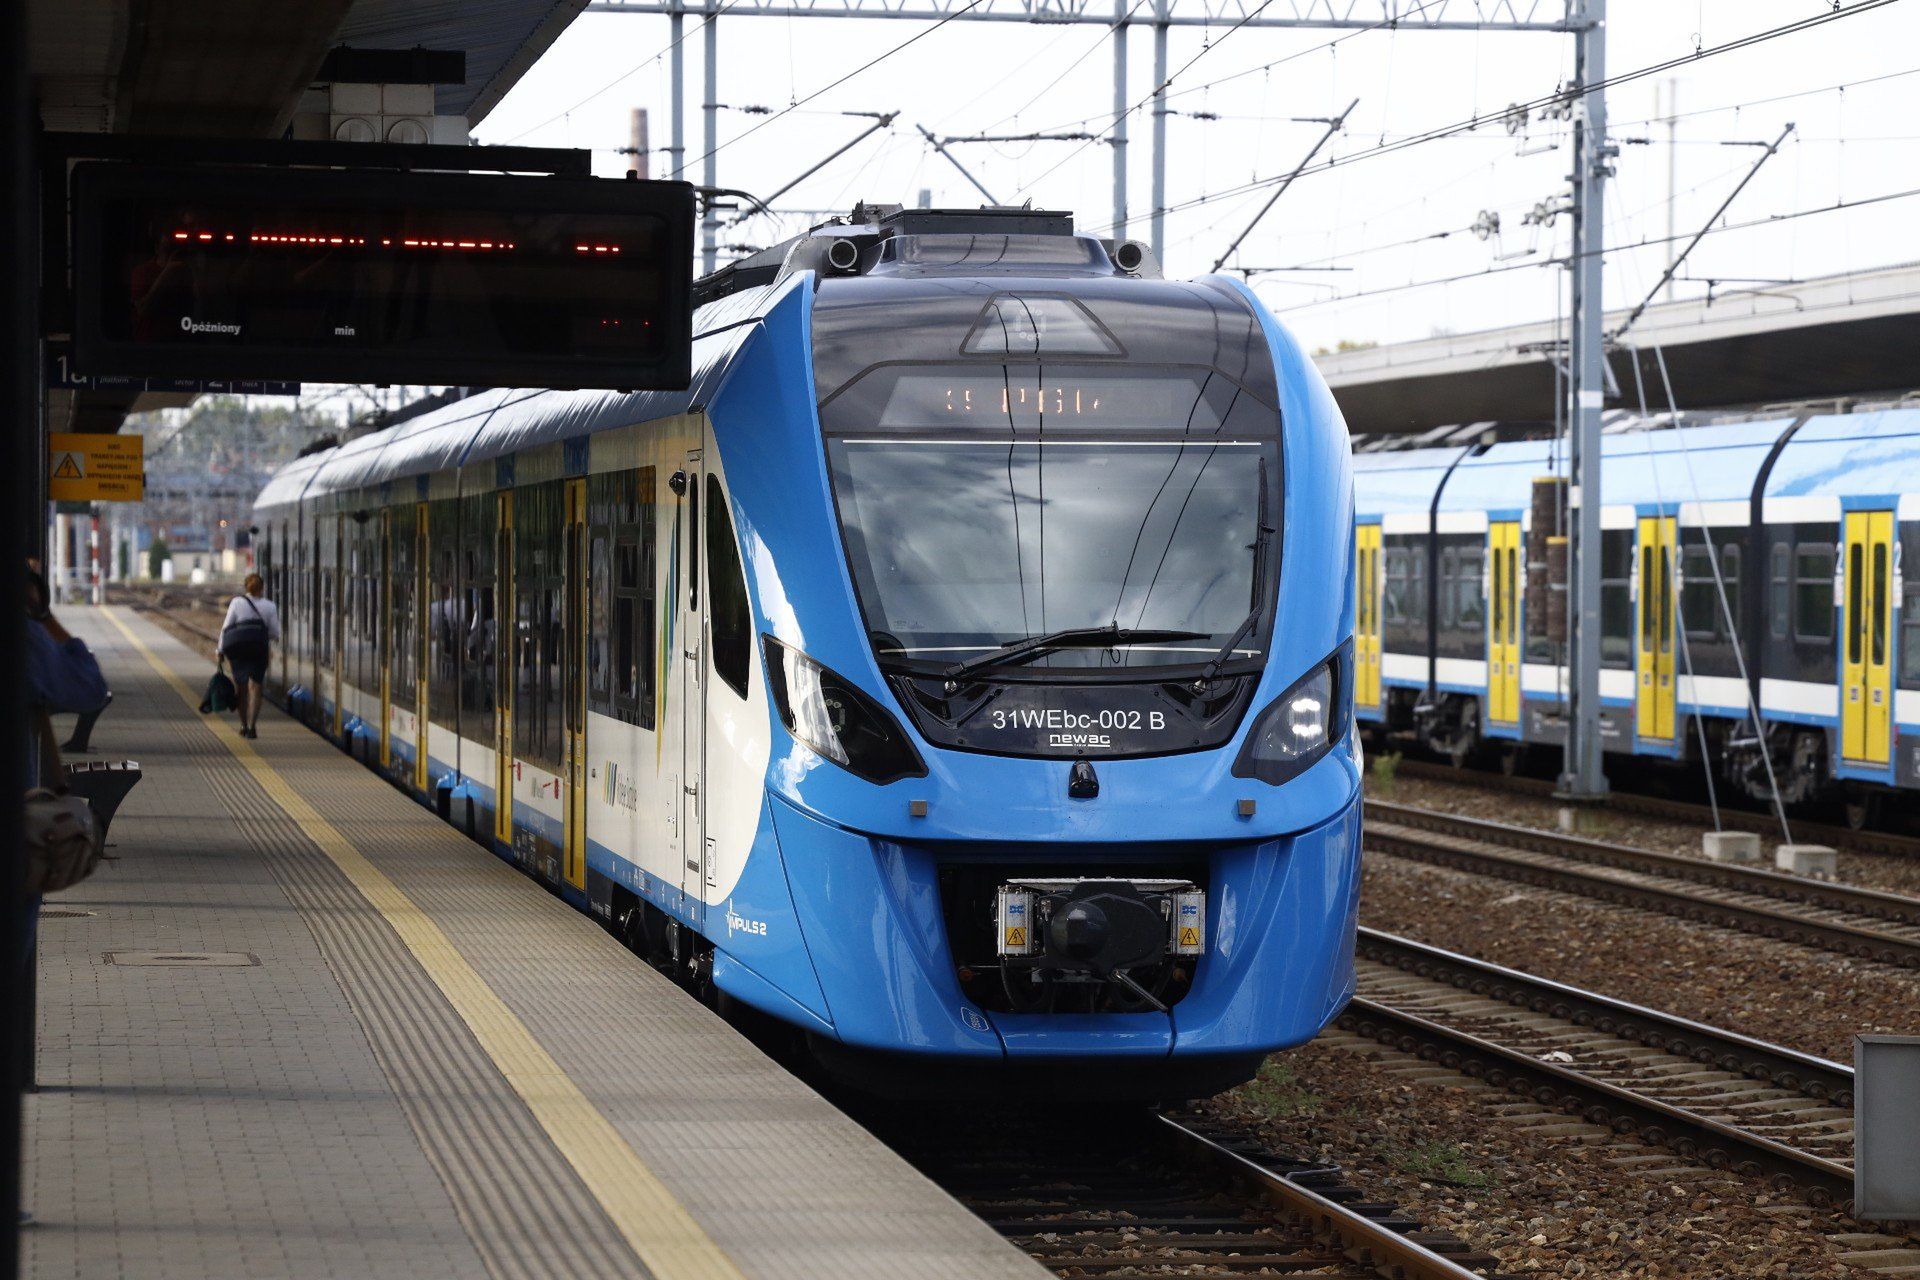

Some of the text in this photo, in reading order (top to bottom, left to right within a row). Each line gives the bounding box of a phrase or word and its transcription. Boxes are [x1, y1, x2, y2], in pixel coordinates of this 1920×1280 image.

[180, 316, 242, 335] Opóźniony
[334, 325, 355, 336] min
[992, 709, 1166, 730] 31WEbc-002 B
[1049, 733, 1111, 747] newag
